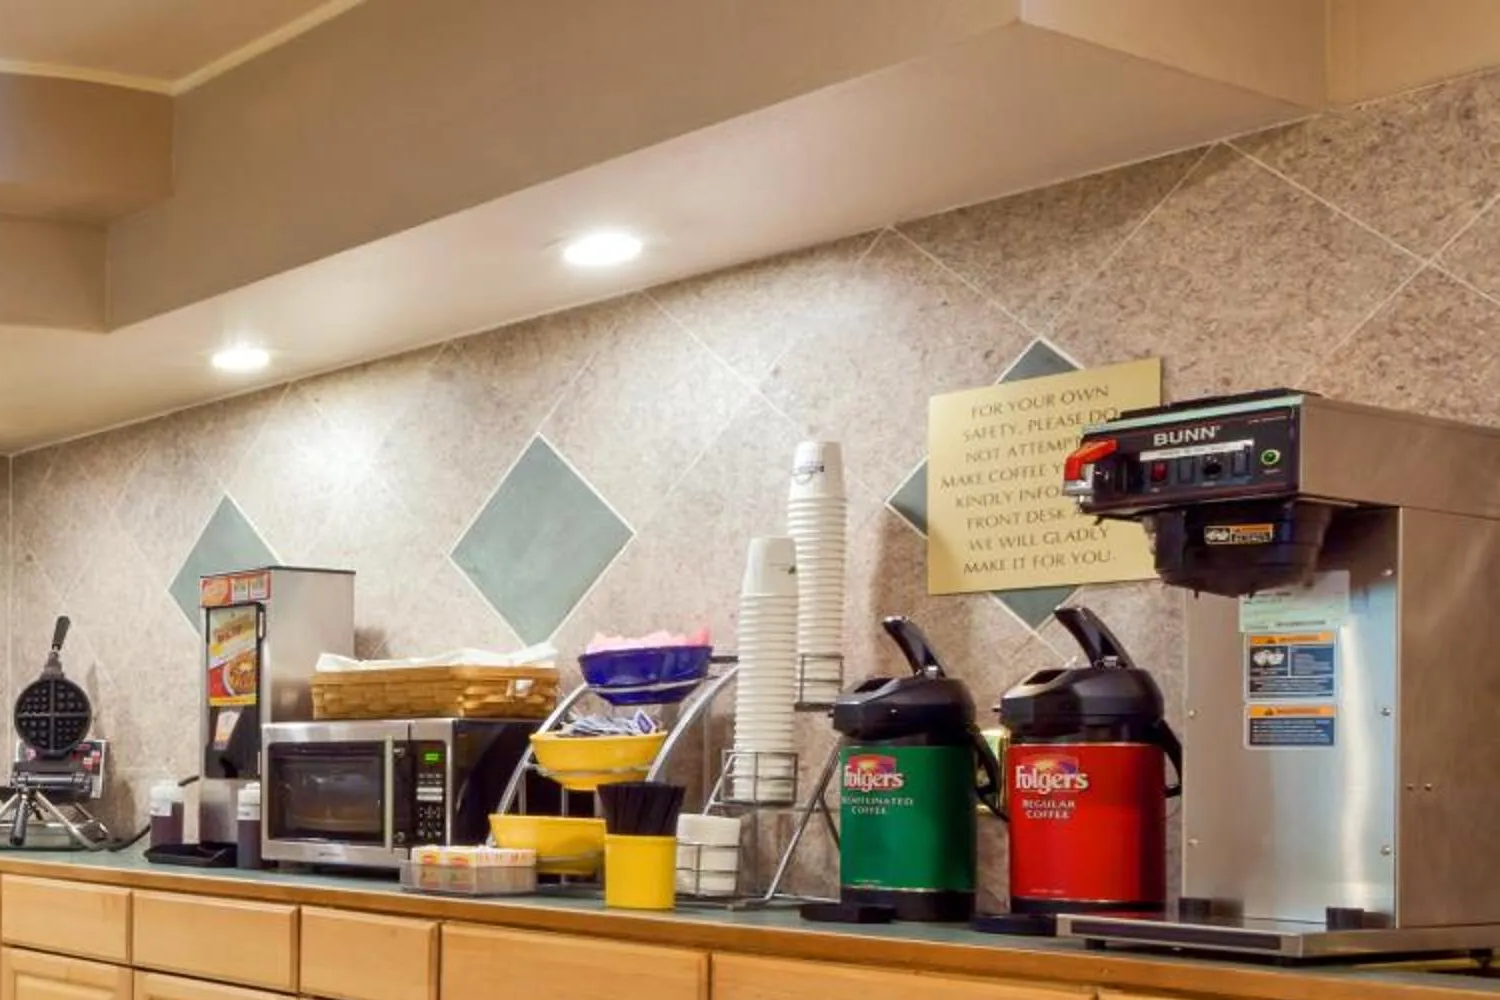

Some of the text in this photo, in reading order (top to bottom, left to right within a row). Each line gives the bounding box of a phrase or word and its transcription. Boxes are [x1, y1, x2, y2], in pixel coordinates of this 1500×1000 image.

[971, 386, 1110, 419] FOR YOUR OWN
[1028, 411, 1084, 432] PLEASE
[1088, 406, 1119, 423] DO
[1153, 426, 1218, 446] BUNN
[965, 448, 1000, 463] NOT
[940, 473, 982, 490] MAKE
[988, 463, 1047, 482] COFFEE
[955, 485, 1061, 509] KINDLY INFO
[966, 511, 1022, 531] FRONT
[1026, 508, 1067, 524] DESK
[969, 537, 994, 551] WE
[998, 533, 1040, 548] WILL
[963, 559, 1006, 574] MAKE
[1013, 556, 1026, 570] IT
[1032, 552, 1066, 569] FOR
[844, 765, 904, 792] Folgers
[1015, 765, 1089, 795] Folgers
